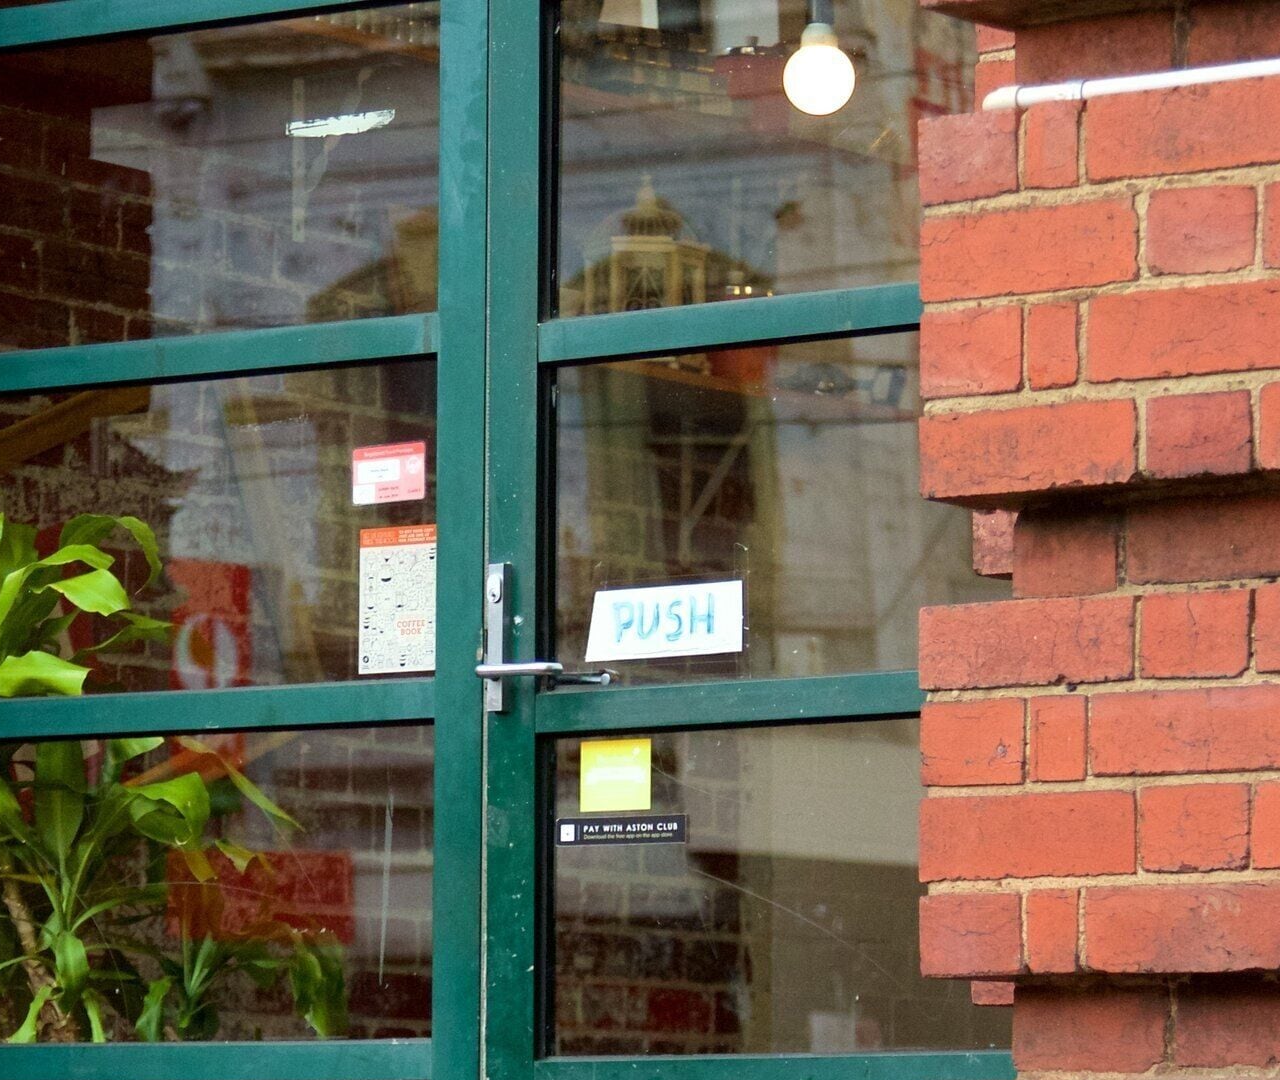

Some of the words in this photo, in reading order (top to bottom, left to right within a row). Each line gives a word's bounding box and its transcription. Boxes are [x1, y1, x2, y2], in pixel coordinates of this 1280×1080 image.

[613, 592, 715, 642] PUSH
[396, 620, 426, 628] COFFEE
[400, 628, 422, 636] BOOK
[583, 825, 600, 833] PAY
[603, 824, 623, 832] WITH
[626, 823, 654, 832] ASTON
[657, 822, 678, 831] CLUB
